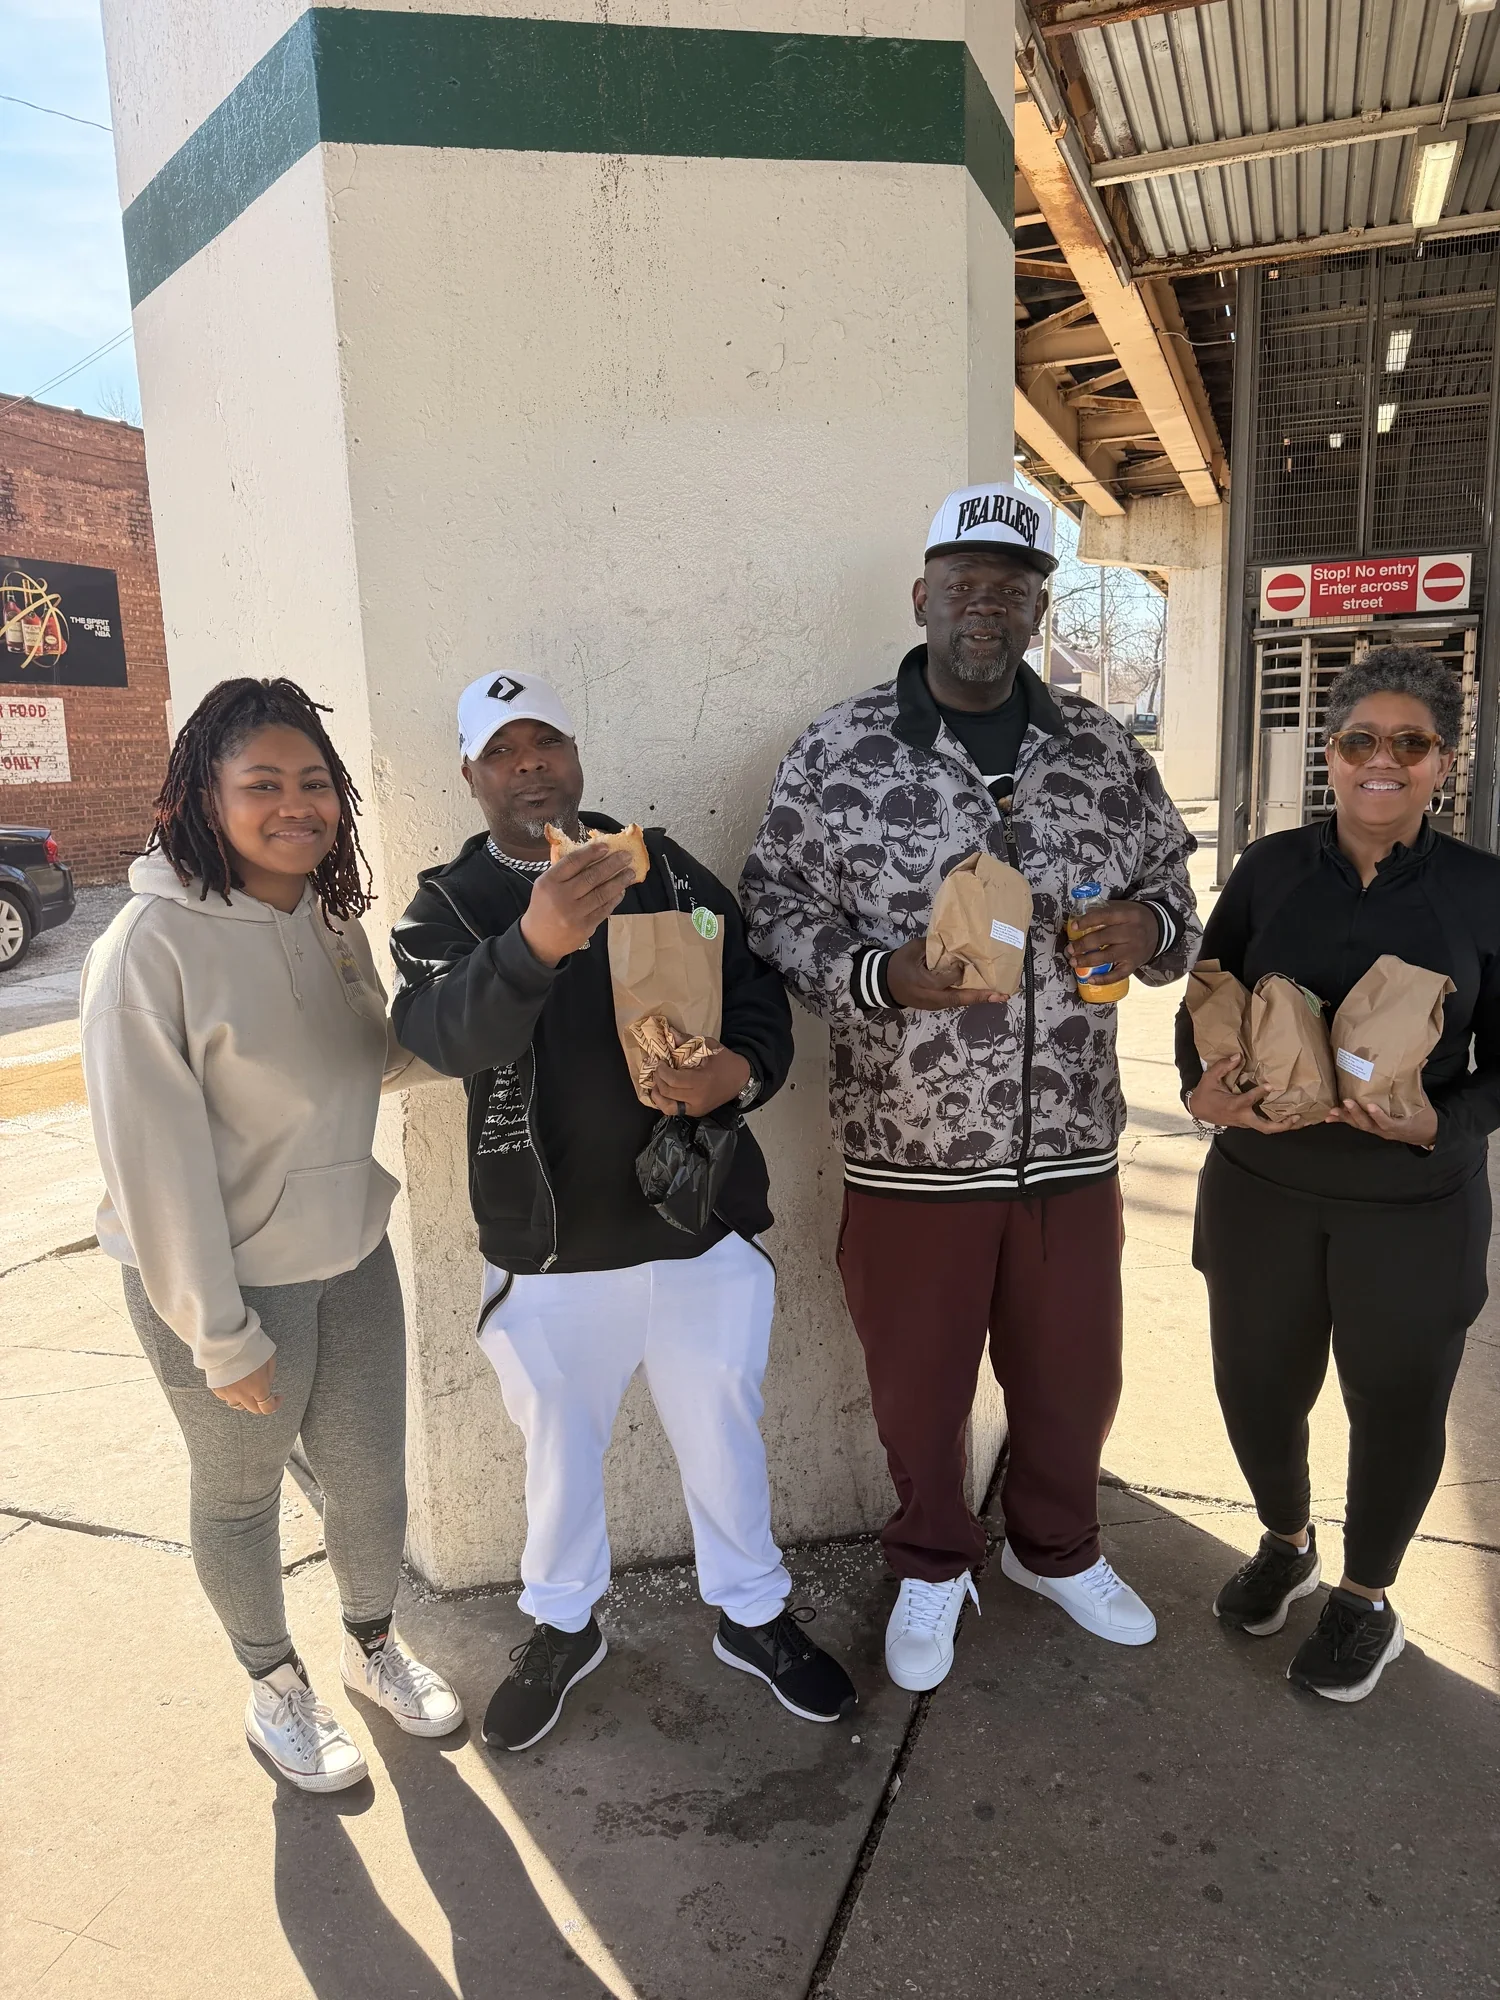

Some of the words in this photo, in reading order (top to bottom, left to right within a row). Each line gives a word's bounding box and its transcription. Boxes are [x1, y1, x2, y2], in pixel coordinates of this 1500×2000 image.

[955, 495, 1040, 548] FEARLESS
[1313, 566, 1351, 582] Stop!
[1355, 565, 1376, 578] No
[1379, 563, 1416, 578] entry
[1319, 583, 1357, 596] Enter
[1360, 581, 1409, 593] across
[1342, 596, 1384, 610] street
[69, 616, 86, 624] THE
[86, 618, 110, 626] SPIRIT
[95, 624, 111, 632] THE
[94, 630, 111, 638] NBA
[8, 703, 47, 718] FOOD
[2, 755, 41, 771] ONLY
